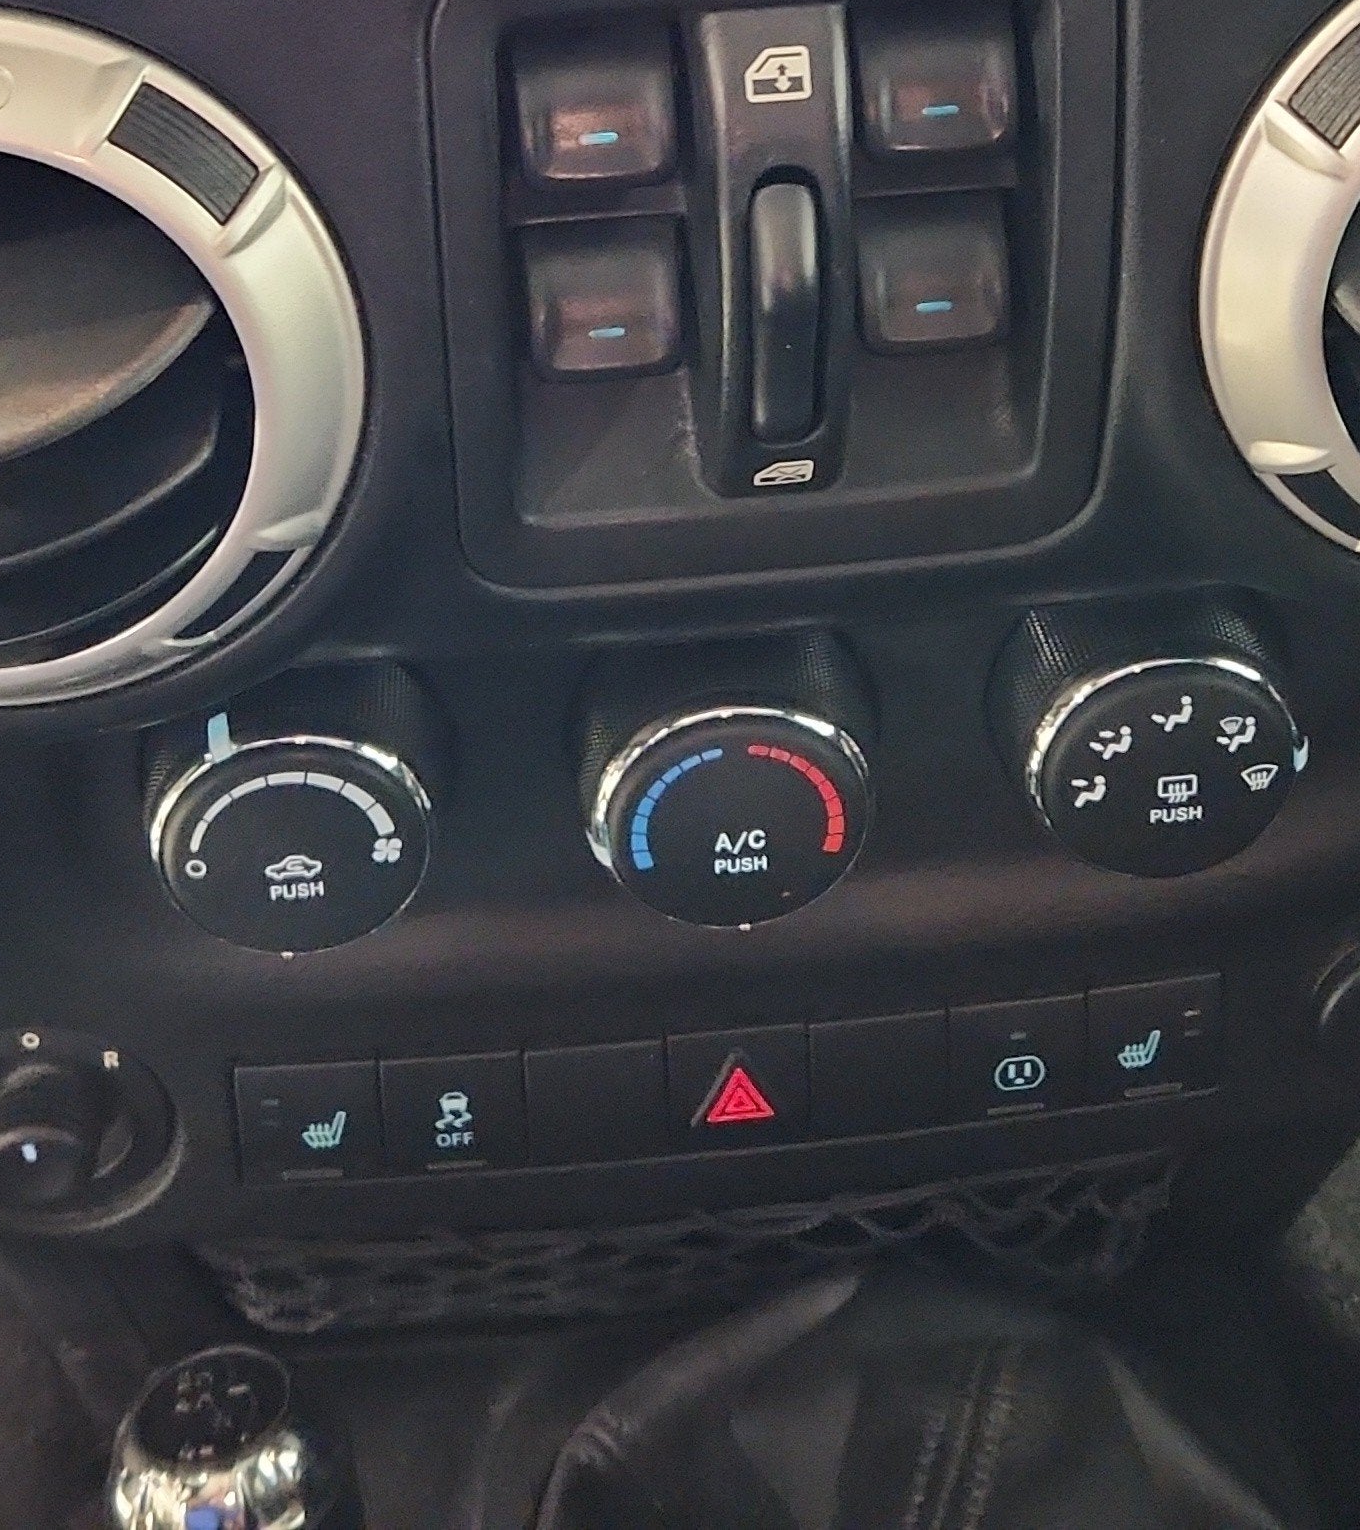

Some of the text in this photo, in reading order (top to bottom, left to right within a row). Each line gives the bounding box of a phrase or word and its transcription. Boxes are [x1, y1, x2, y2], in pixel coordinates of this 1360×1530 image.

[1149, 805, 1203, 825] PUSH
[714, 829, 767, 855] A/C
[713, 854, 769, 875] PUSH
[269, 880, 325, 901] PUSH
[103, 1050, 120, 1070] R
[435, 1131, 475, 1149] OFF
